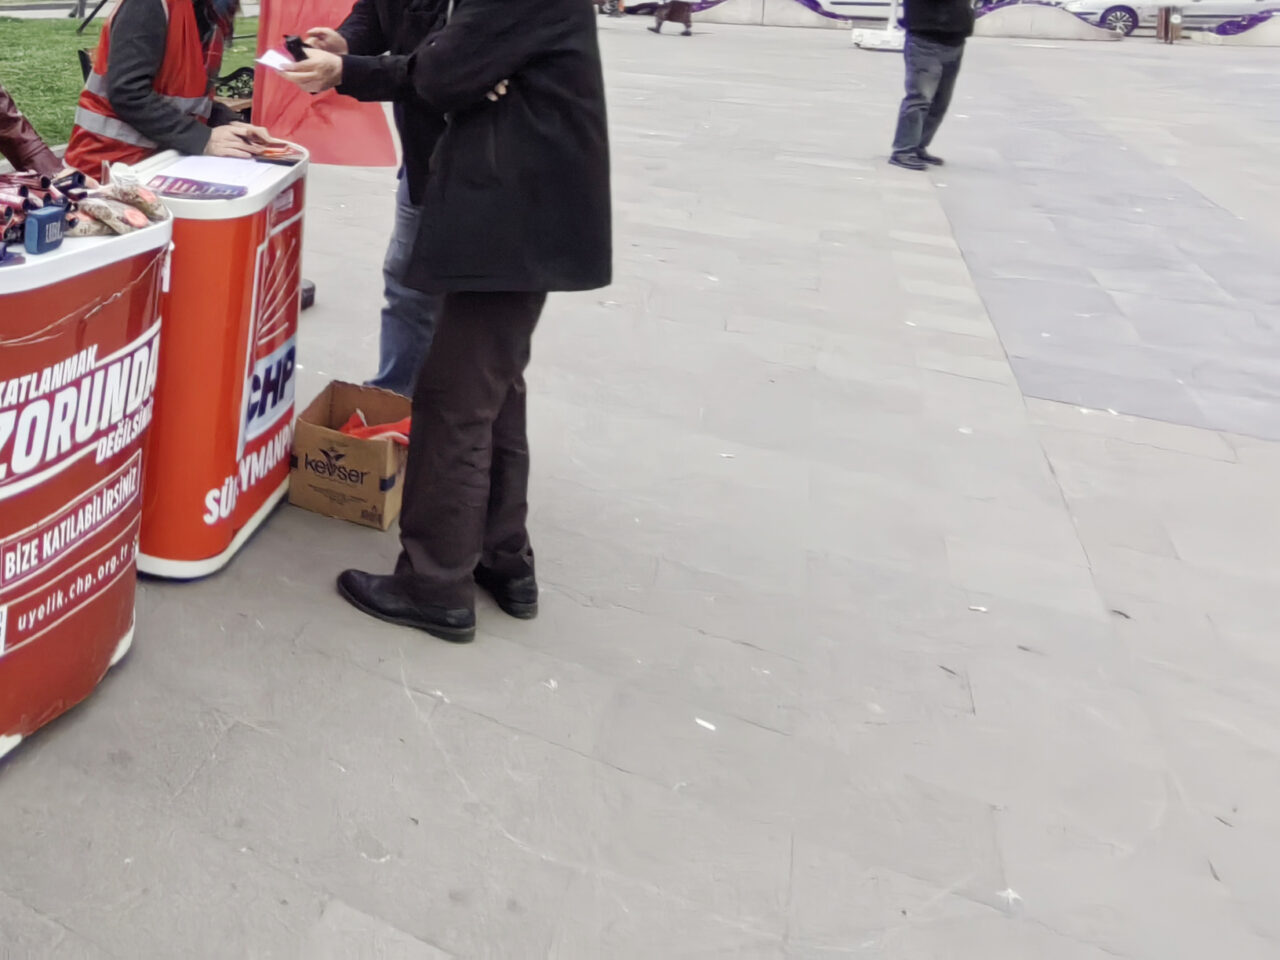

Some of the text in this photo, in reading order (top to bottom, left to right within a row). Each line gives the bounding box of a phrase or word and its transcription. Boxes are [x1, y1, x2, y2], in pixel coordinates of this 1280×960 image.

[45, 220, 63, 243] JBL
[247, 344, 296, 422] CHP
[4, 467, 137, 580] BİZE KATILABİLİRSİNİZ
[18, 543, 128, 631] uyelik.chp.org.tr
